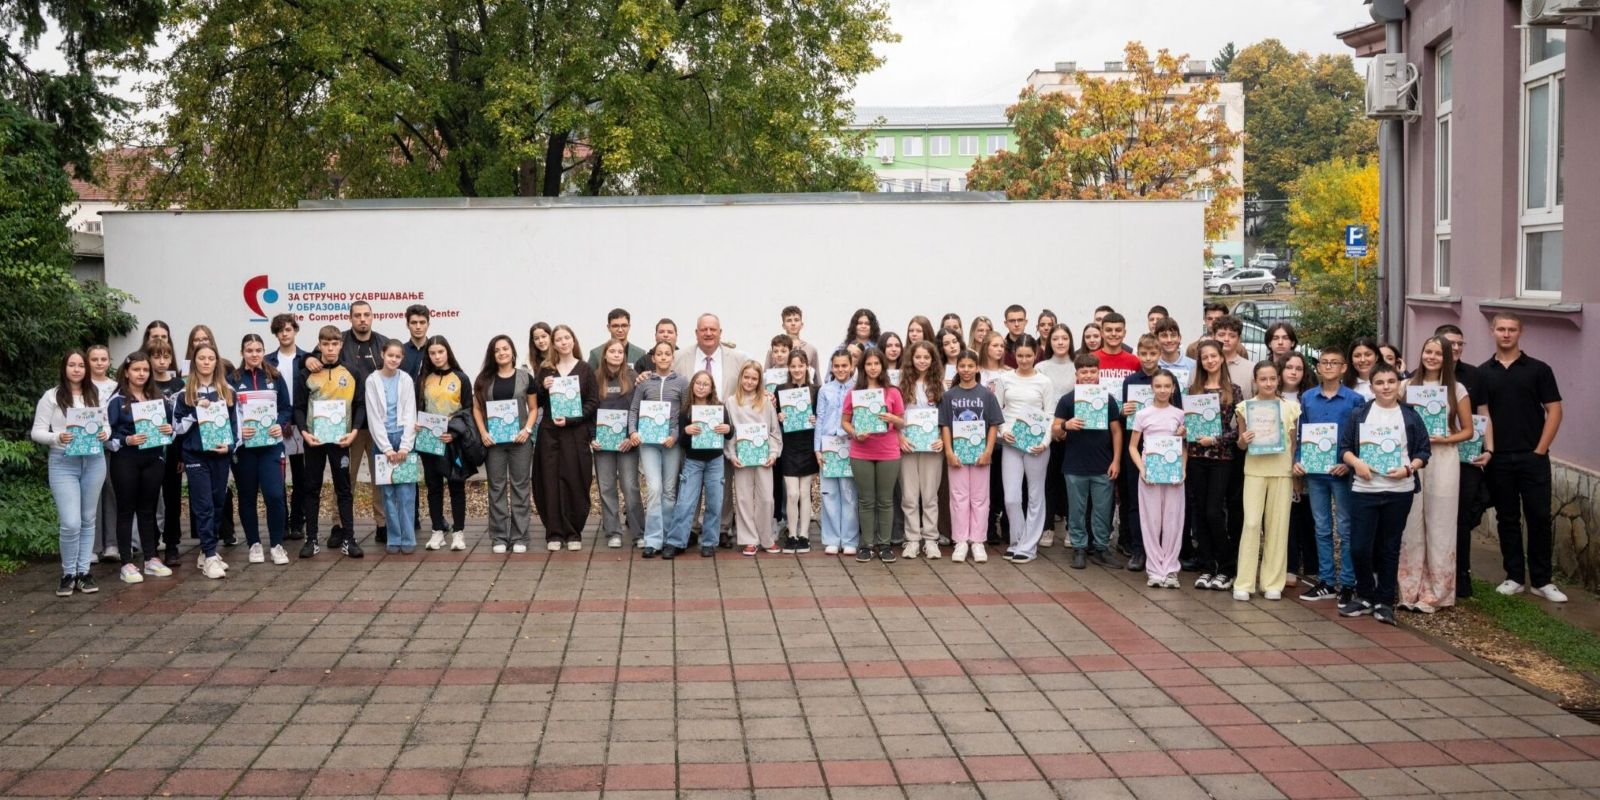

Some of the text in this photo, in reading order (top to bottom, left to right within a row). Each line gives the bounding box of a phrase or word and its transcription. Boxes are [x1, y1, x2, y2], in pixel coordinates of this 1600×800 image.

[287, 282, 326, 291] ЦЕНТАР
[288, 291, 425, 301] ЗА СТРУЧНО УСАВРШАВАЊЕ
[288, 302, 351, 311] У ОБРАЗОВА
[308, 313, 350, 322] Compete
[429, 309, 460, 318] Center
[951, 397, 984, 408] Stitch
